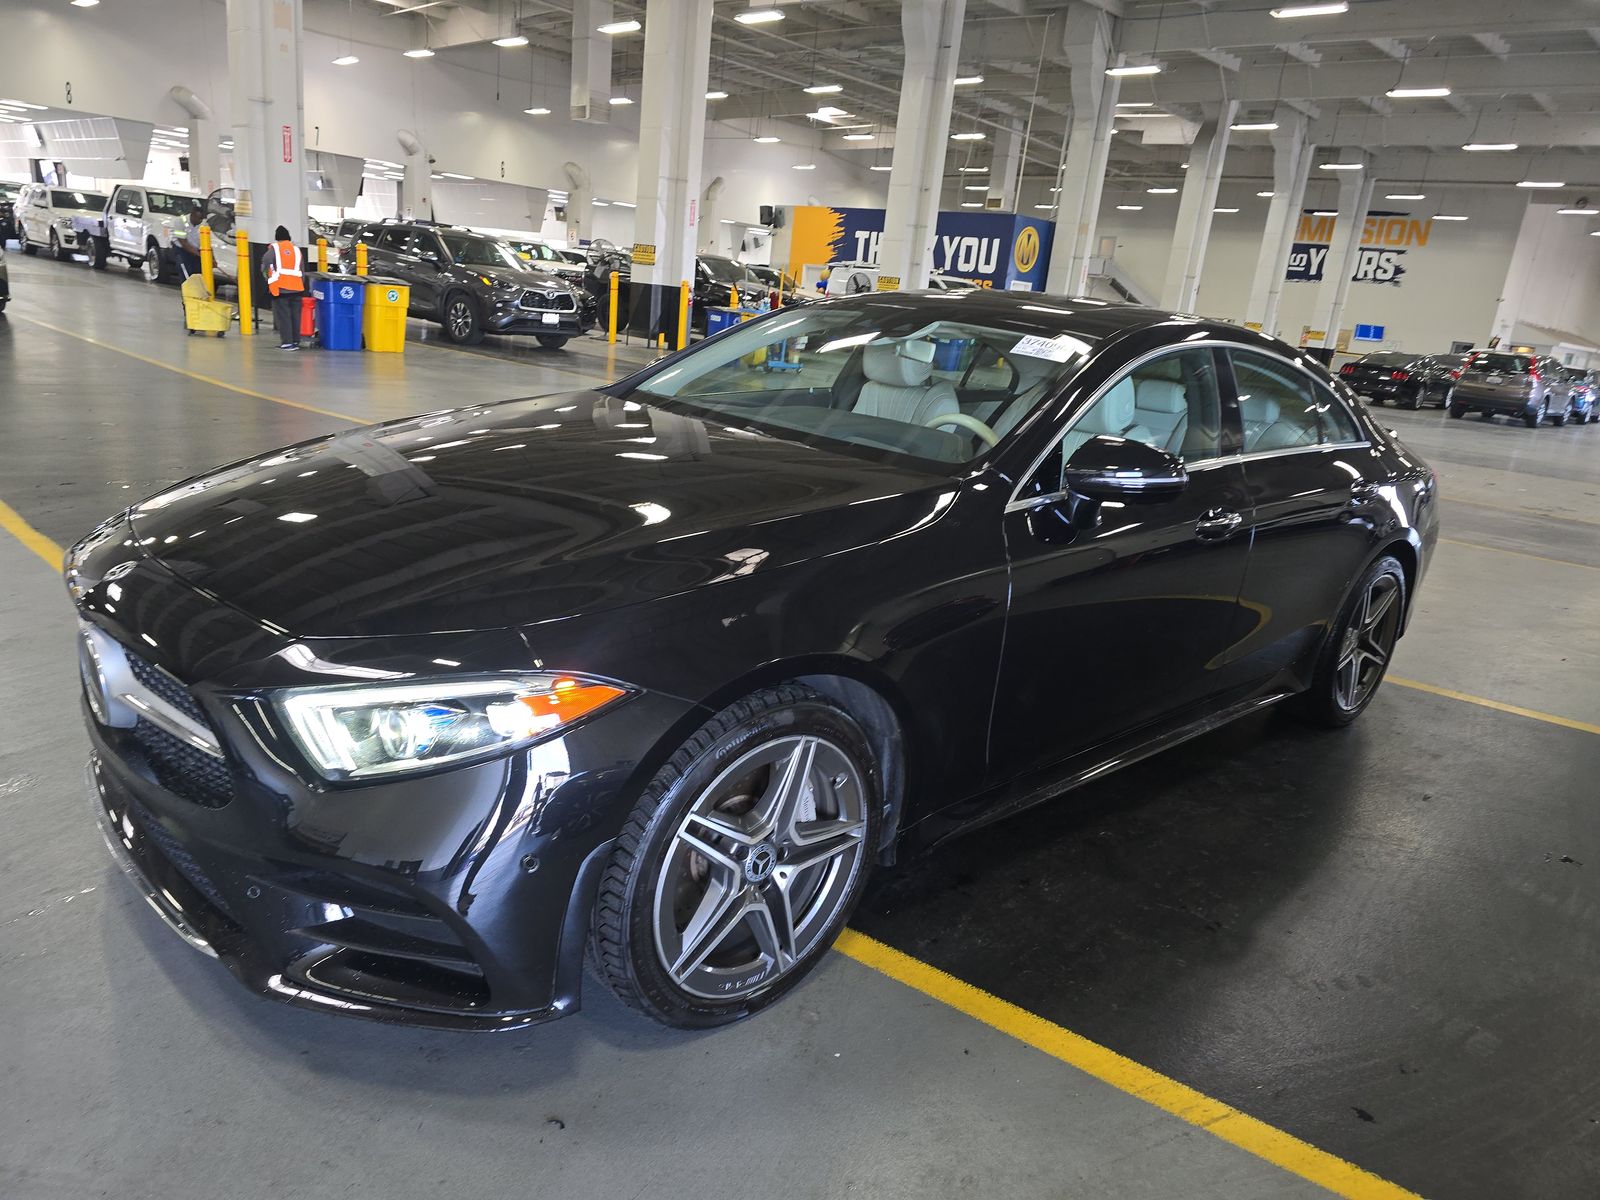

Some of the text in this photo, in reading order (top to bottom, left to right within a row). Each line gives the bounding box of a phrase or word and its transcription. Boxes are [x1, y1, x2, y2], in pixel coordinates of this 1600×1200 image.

[1297, 216, 1433, 247] MISION
[942, 235, 1000, 274] YOU
[1308, 248, 1397, 281] YRS
